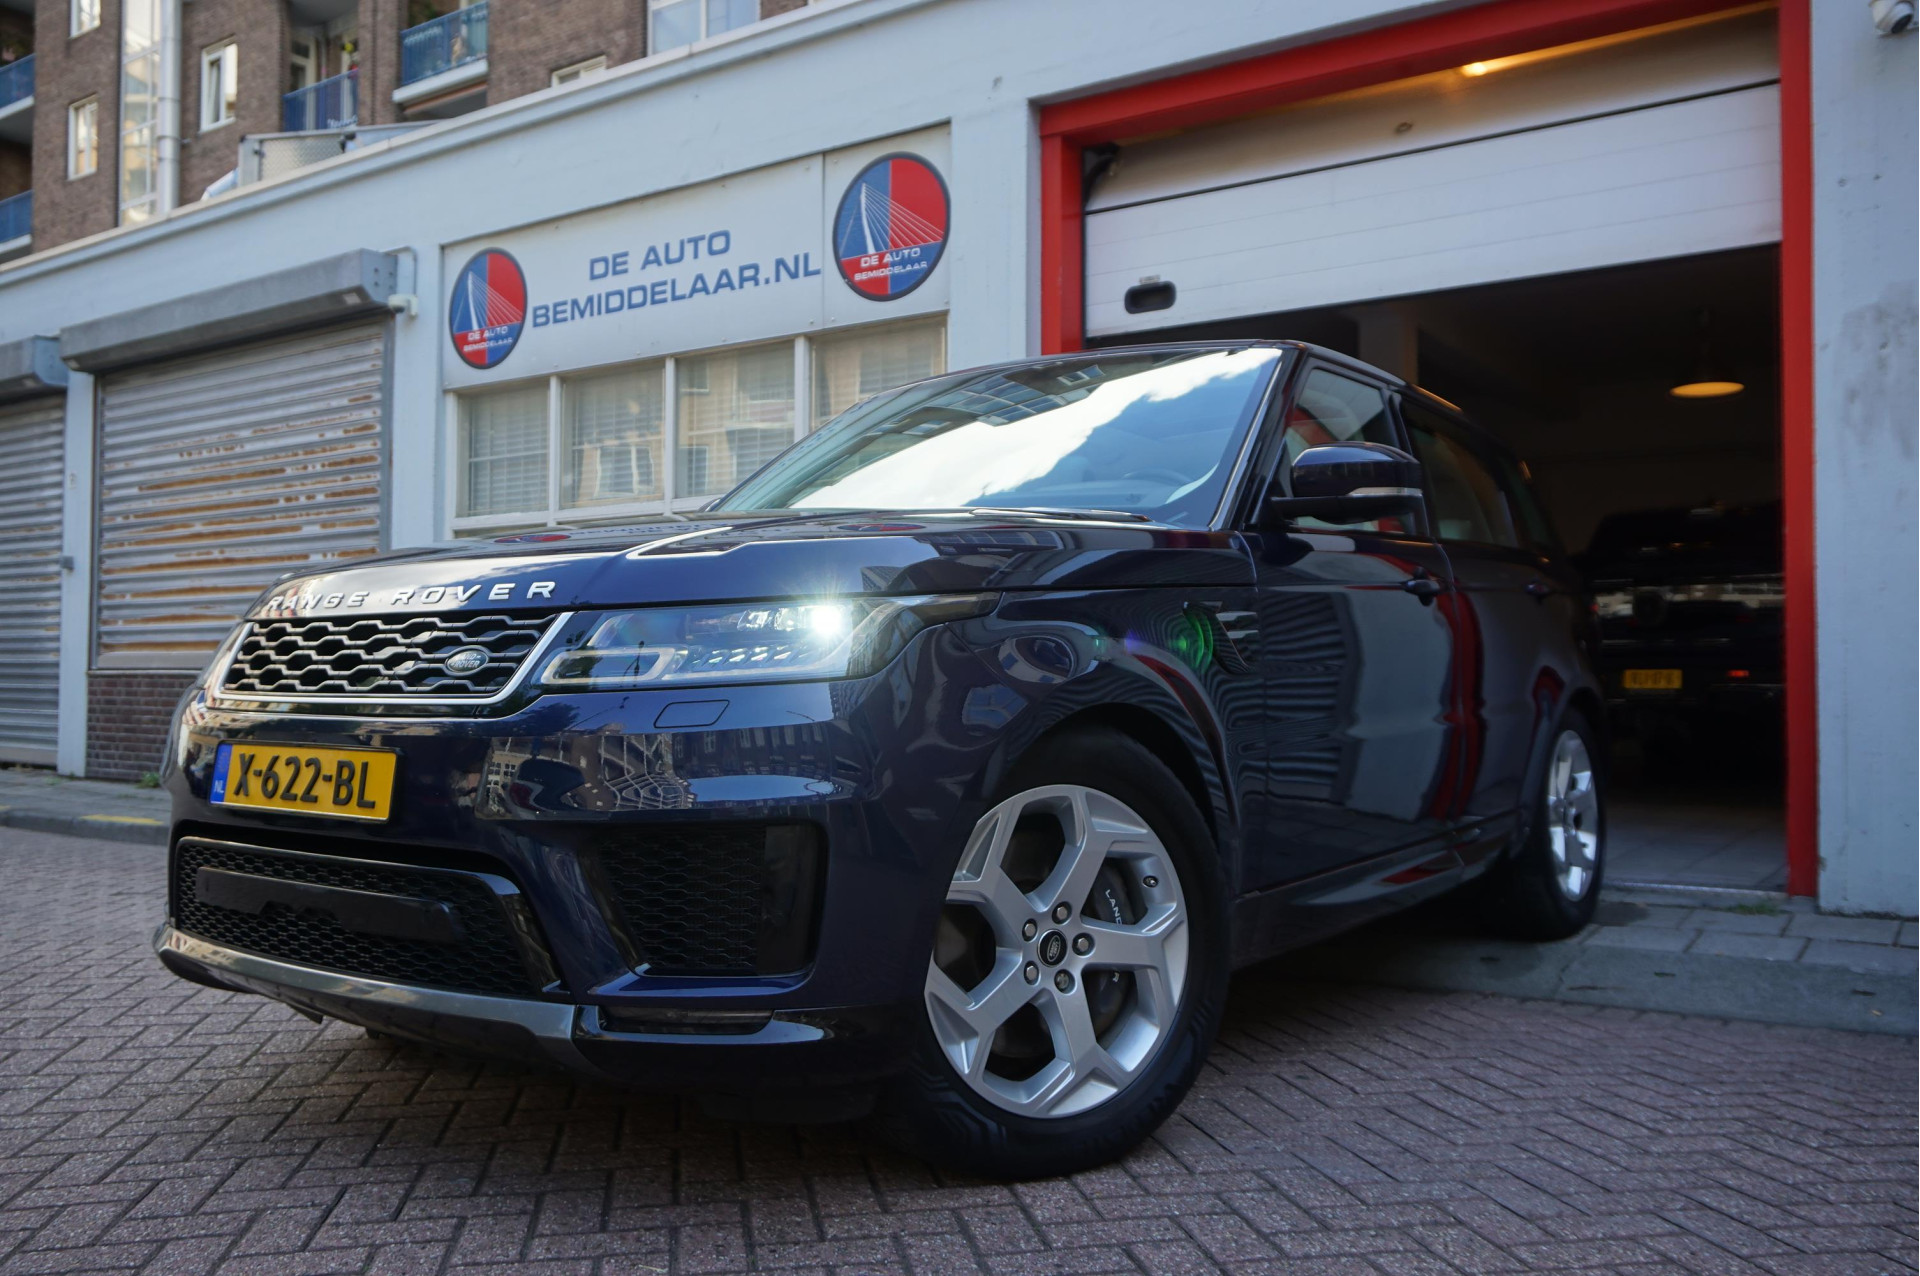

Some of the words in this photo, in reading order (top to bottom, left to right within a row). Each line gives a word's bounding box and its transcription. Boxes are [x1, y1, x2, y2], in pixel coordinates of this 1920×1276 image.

[589, 251, 630, 281] DE
[641, 229, 731, 271] AUTO
[861, 255, 879, 268] DE
[883, 247, 921, 263] AUTO
[854, 261, 928, 281] BEMIDDELAAR
[532, 251, 822, 329] BEMIDDELAAR.NL
[468, 331, 481, 342] DE
[483, 325, 509, 338] AUTO
[266, 590, 371, 611] RANGE
[390, 580, 557, 605] ROVER
[214, 780, 225, 793] NL
[232, 752, 376, 810] X-622-BL
